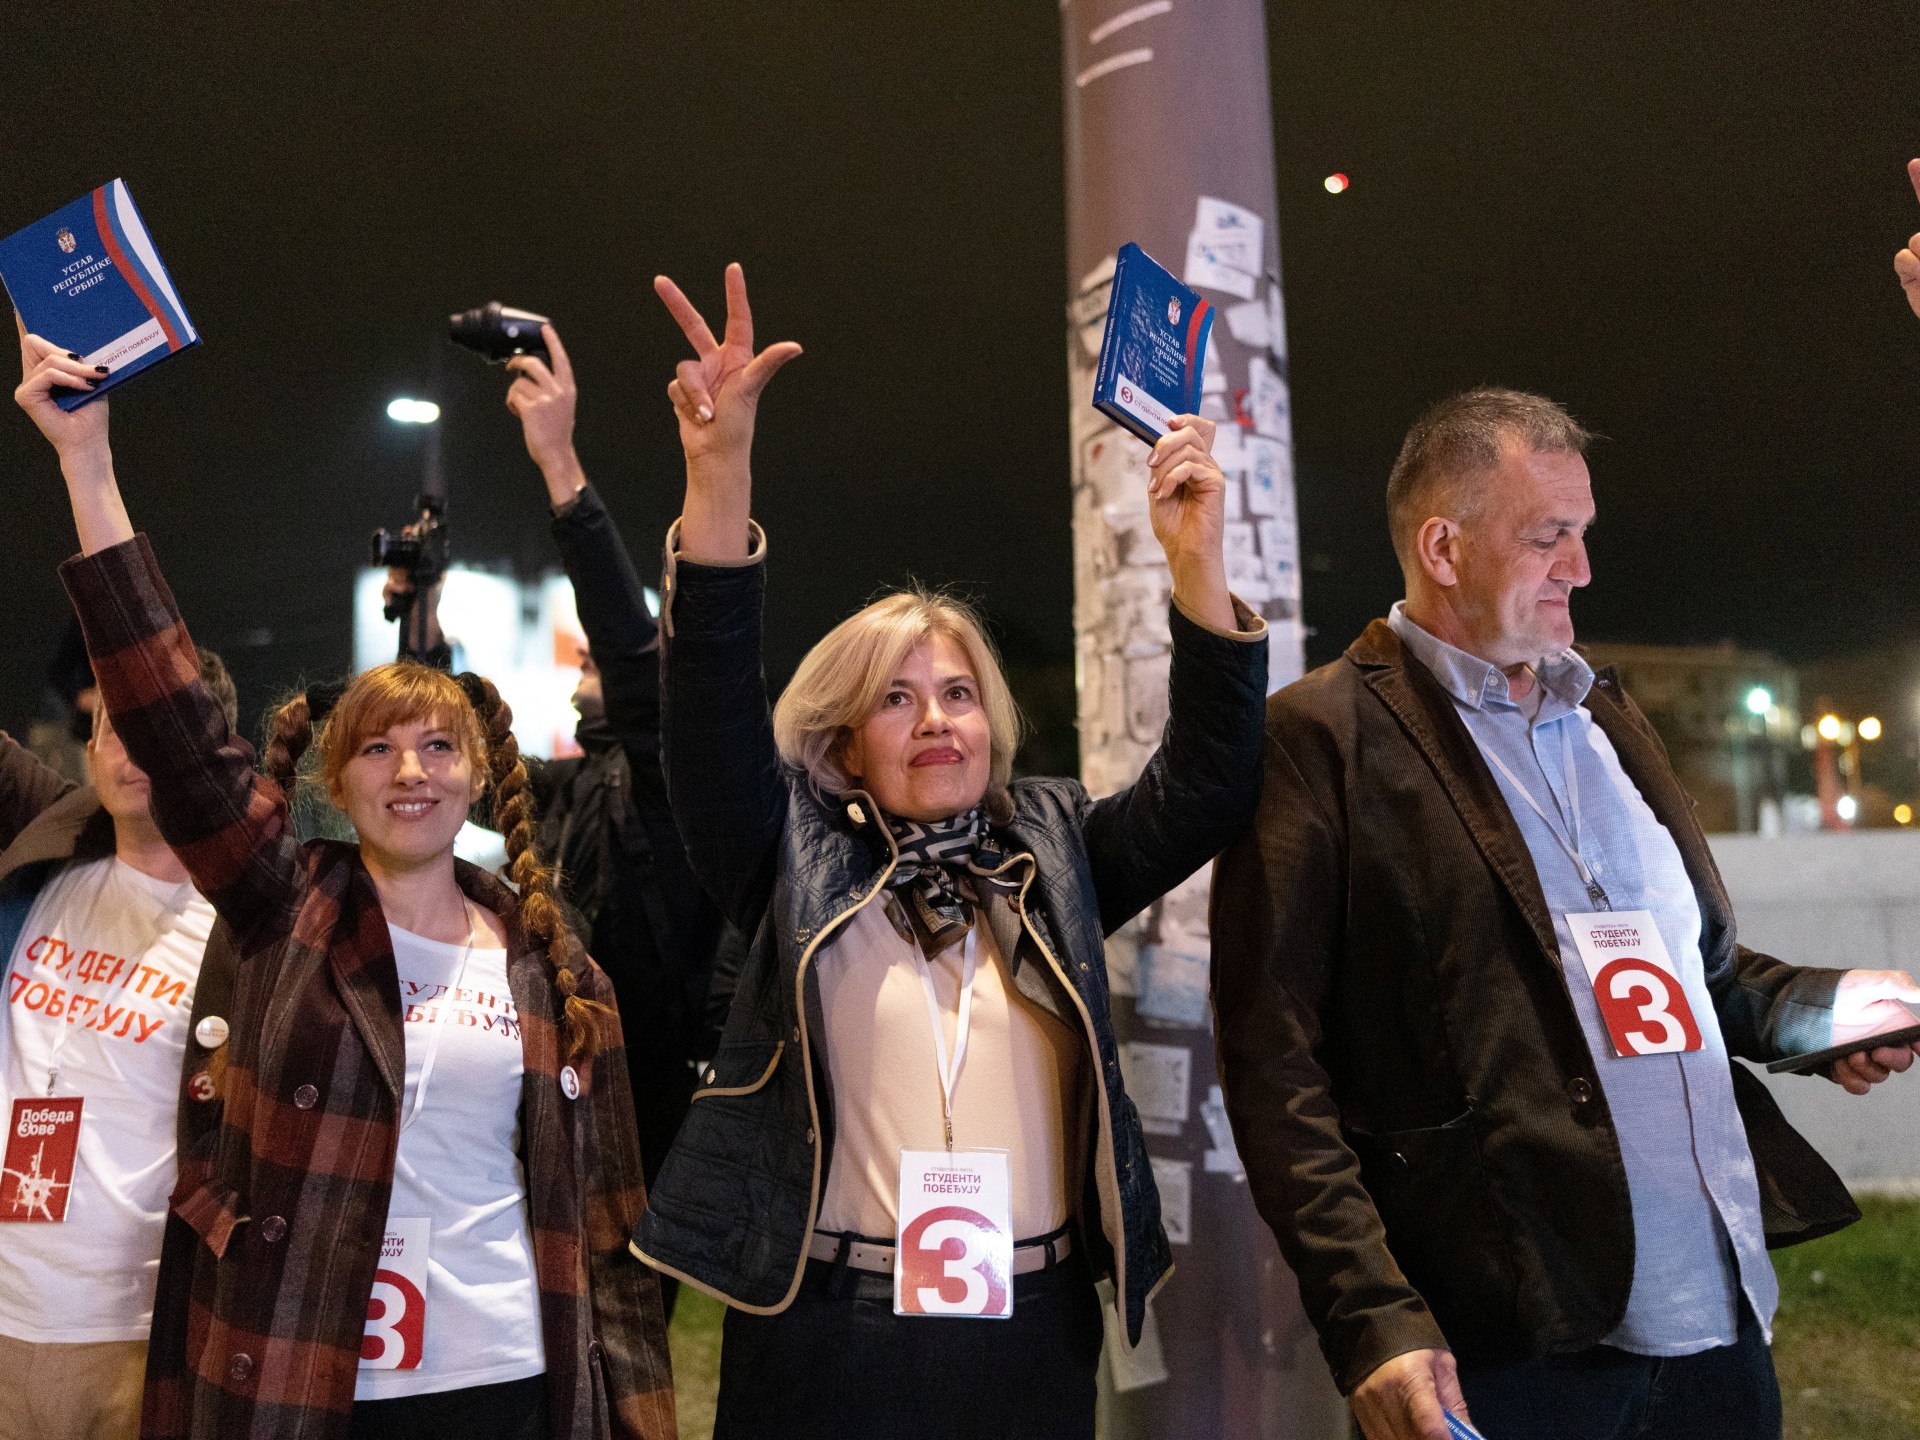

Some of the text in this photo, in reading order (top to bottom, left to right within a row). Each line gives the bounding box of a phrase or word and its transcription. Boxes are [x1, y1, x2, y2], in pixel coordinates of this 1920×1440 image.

[52, 256, 112, 294] РЕПУБЛИКЕ
[61, 254, 93, 275] УСТАВ
[68, 273, 105, 297] СРБИЈЕ
[127, 329, 160, 352] ПОБЕЂУЈУ
[1149, 331, 1187, 364] РЕПУБЛИКЕ
[1159, 329, 1180, 349] УСТАВ
[1154, 346, 1179, 369] СРБИЈЕ
[1590, 928, 1639, 939] СТУДЕНТИ
[1593, 937, 1641, 949] ПОБЕЂУЈУ
[26, 934, 188, 1006] СТУДЕНТИ
[1609, 969, 1687, 1055] 3
[20, 1108, 75, 1124] Победа
[923, 1172, 982, 1184] СТУДЕНТИ
[923, 1183, 982, 1194] ПОБЕЂУЈУ
[916, 1219, 990, 1315] 3
[360, 1281, 407, 1369] 3
